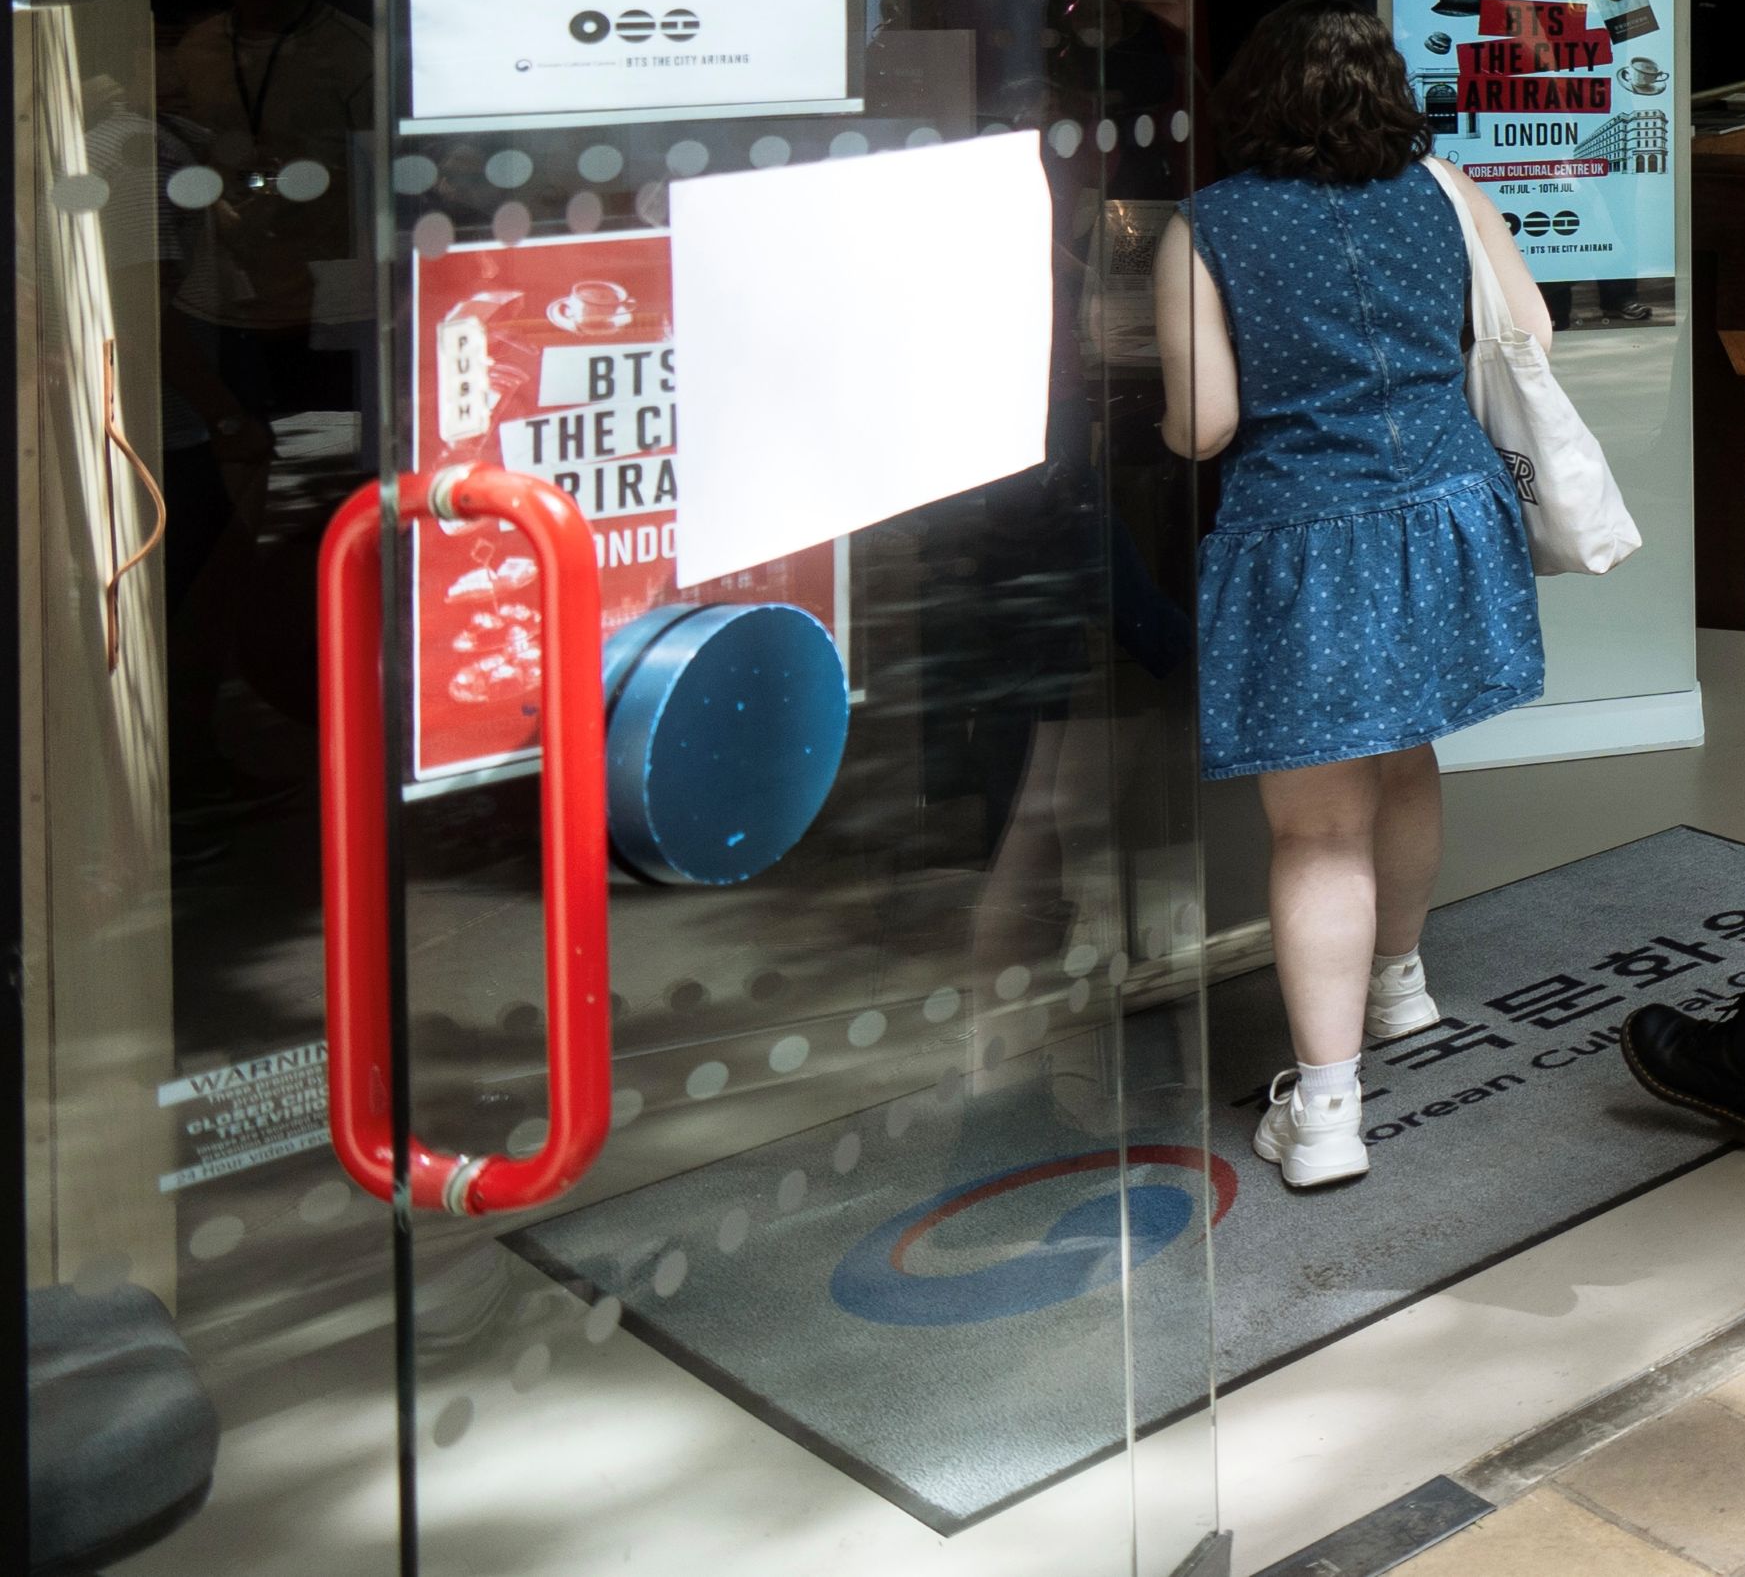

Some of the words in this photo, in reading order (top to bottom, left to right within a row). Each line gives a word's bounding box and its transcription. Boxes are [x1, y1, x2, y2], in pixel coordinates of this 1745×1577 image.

[1506, 6, 1563, 37] BTS
[626, 57, 648, 68] BTS
[652, 56, 671, 67] THE
[674, 55, 697, 67] CITY
[701, 53, 750, 65] ARIRANG
[1473, 43, 1522, 74] THE
[1533, 41, 1599, 72] CITY
[1465, 78, 1606, 113] ARIRANG
[1494, 122, 1578, 146] LONDON
[1468, 165, 1505, 179] KOREAN
[1508, 164, 1552, 177] CULTURAL
[1554, 163, 1589, 175] CENTRE
[1591, 163, 1604, 174] UK
[1499, 184, 1514, 194] 4TH
[1517, 184, 1530, 194] JUL
[1539, 184, 1559, 194] 10TH
[1561, 183, 1574, 193] JUL
[1530, 246, 1545, 254] BTS
[1548, 245, 1560, 253] THE
[1562, 244, 1577, 253] CITY
[1580, 243, 1613, 252] ARIRANG
[457, 335, 471, 418] PUSH
[525, 410, 616, 464] THE
[636, 402, 677, 452] CI
[554, 458, 677, 513] RIRA
[594, 523, 677, 569] ONDO
[189, 1044, 328, 1095] WARNIN
[216, 1097, 328, 1139] TELEVISIO
[1365, 1072, 1527, 1147] orean
